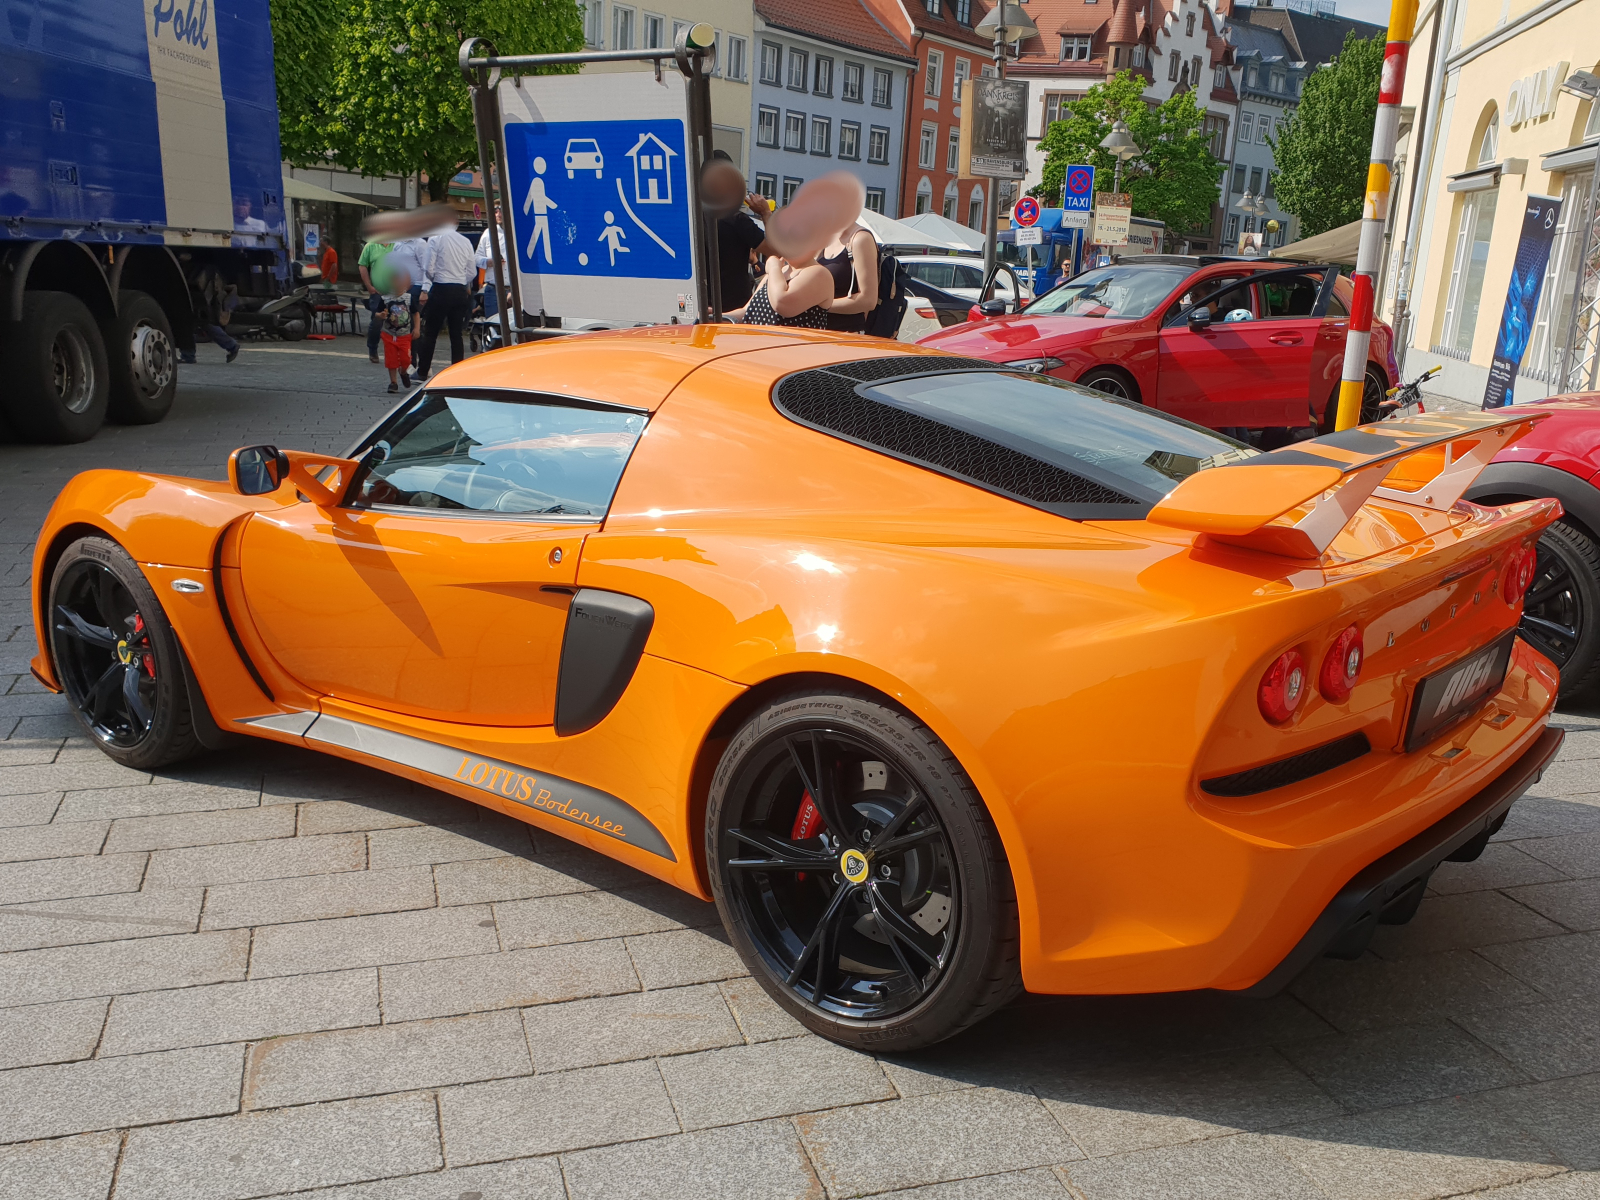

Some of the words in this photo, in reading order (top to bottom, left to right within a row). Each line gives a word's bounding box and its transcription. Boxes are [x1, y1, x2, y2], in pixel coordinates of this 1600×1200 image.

[153, 0, 209, 50] Pohl
[1504, 61, 1570, 127] ONLY
[1064, 216, 1087, 225] Anfang
[1067, 197, 1089, 208] TAXI
[1387, 579, 1498, 648] LOTUS
[850, 709, 905, 740] 265/35
[453, 756, 537, 801] LOTUS
[533, 788, 626, 837] Bodensee
[797, 804, 813, 840] LOTUS
[847, 861, 864, 875] LOTUS
